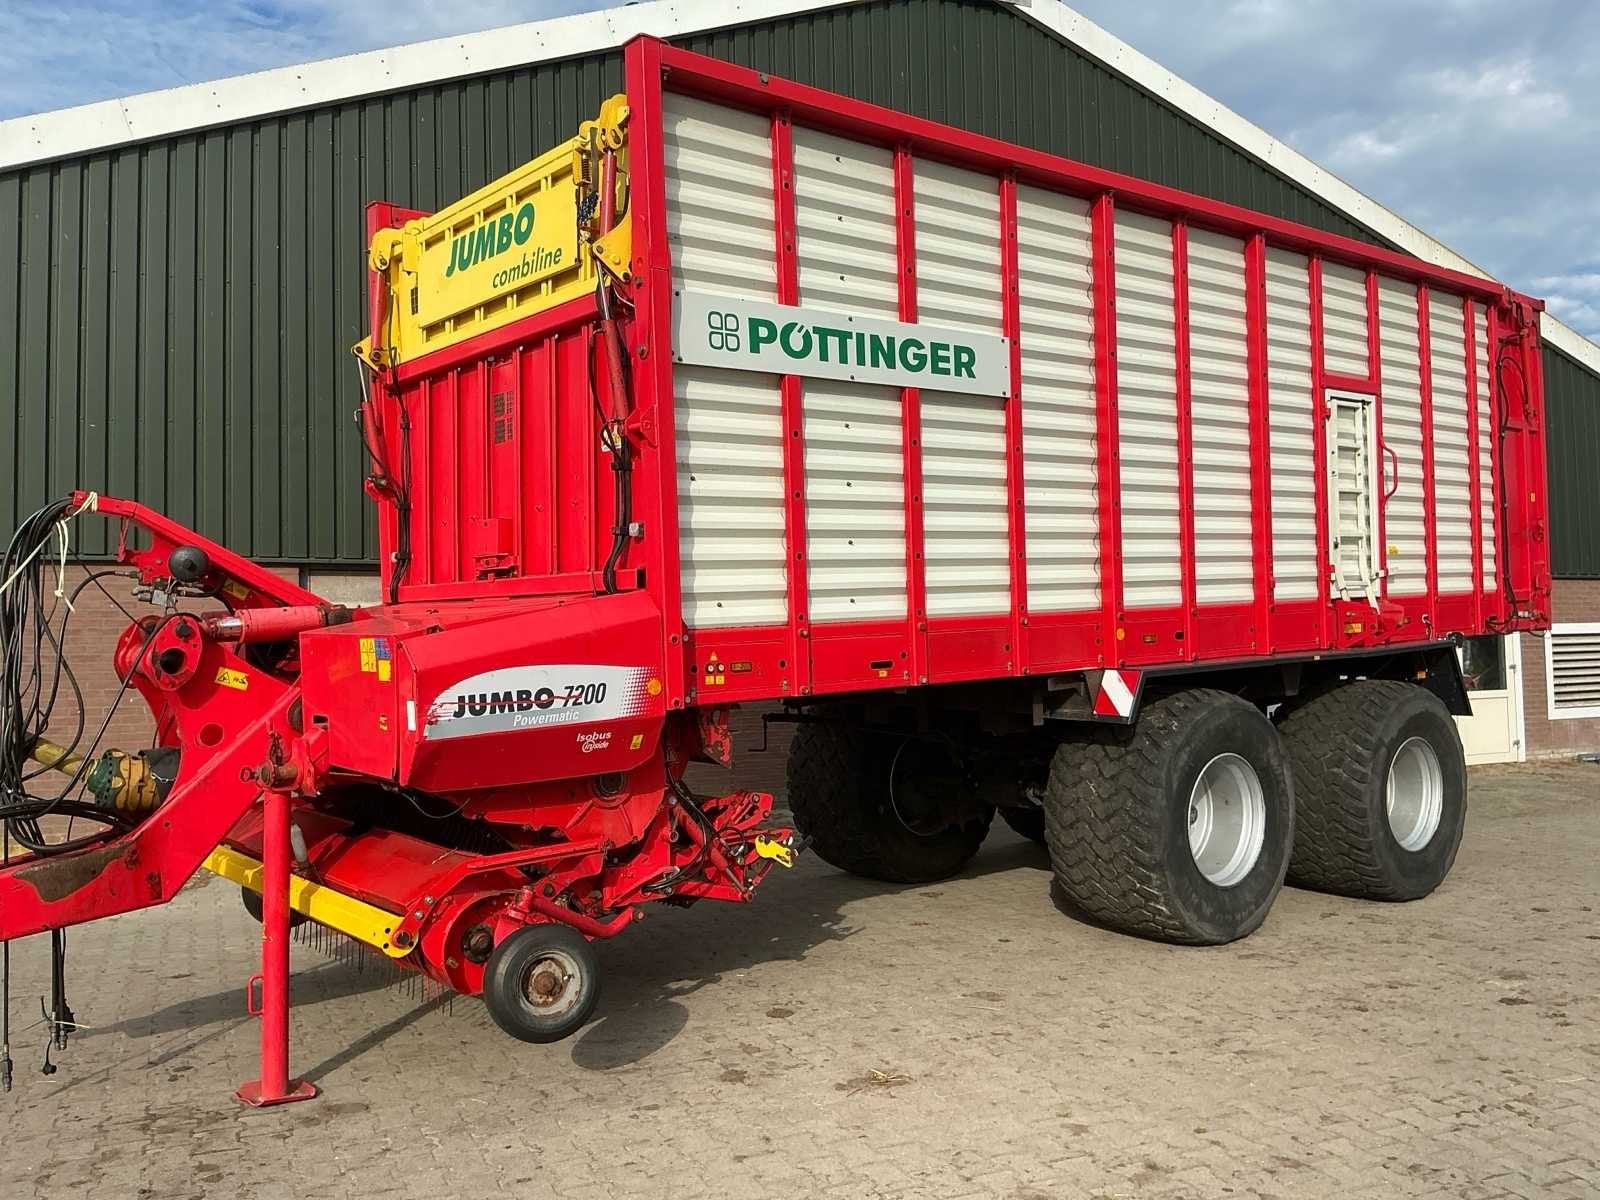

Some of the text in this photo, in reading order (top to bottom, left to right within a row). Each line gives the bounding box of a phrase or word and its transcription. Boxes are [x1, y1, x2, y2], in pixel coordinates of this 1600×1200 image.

[446, 202, 535, 278] JUMBO
[493, 247, 562, 289] combiline
[748, 317, 977, 379] PÖTTINGER
[453, 682, 607, 718] JUMBO 7200
[513, 709, 579, 728] Powermatic
[576, 731, 612, 742] Isobus
